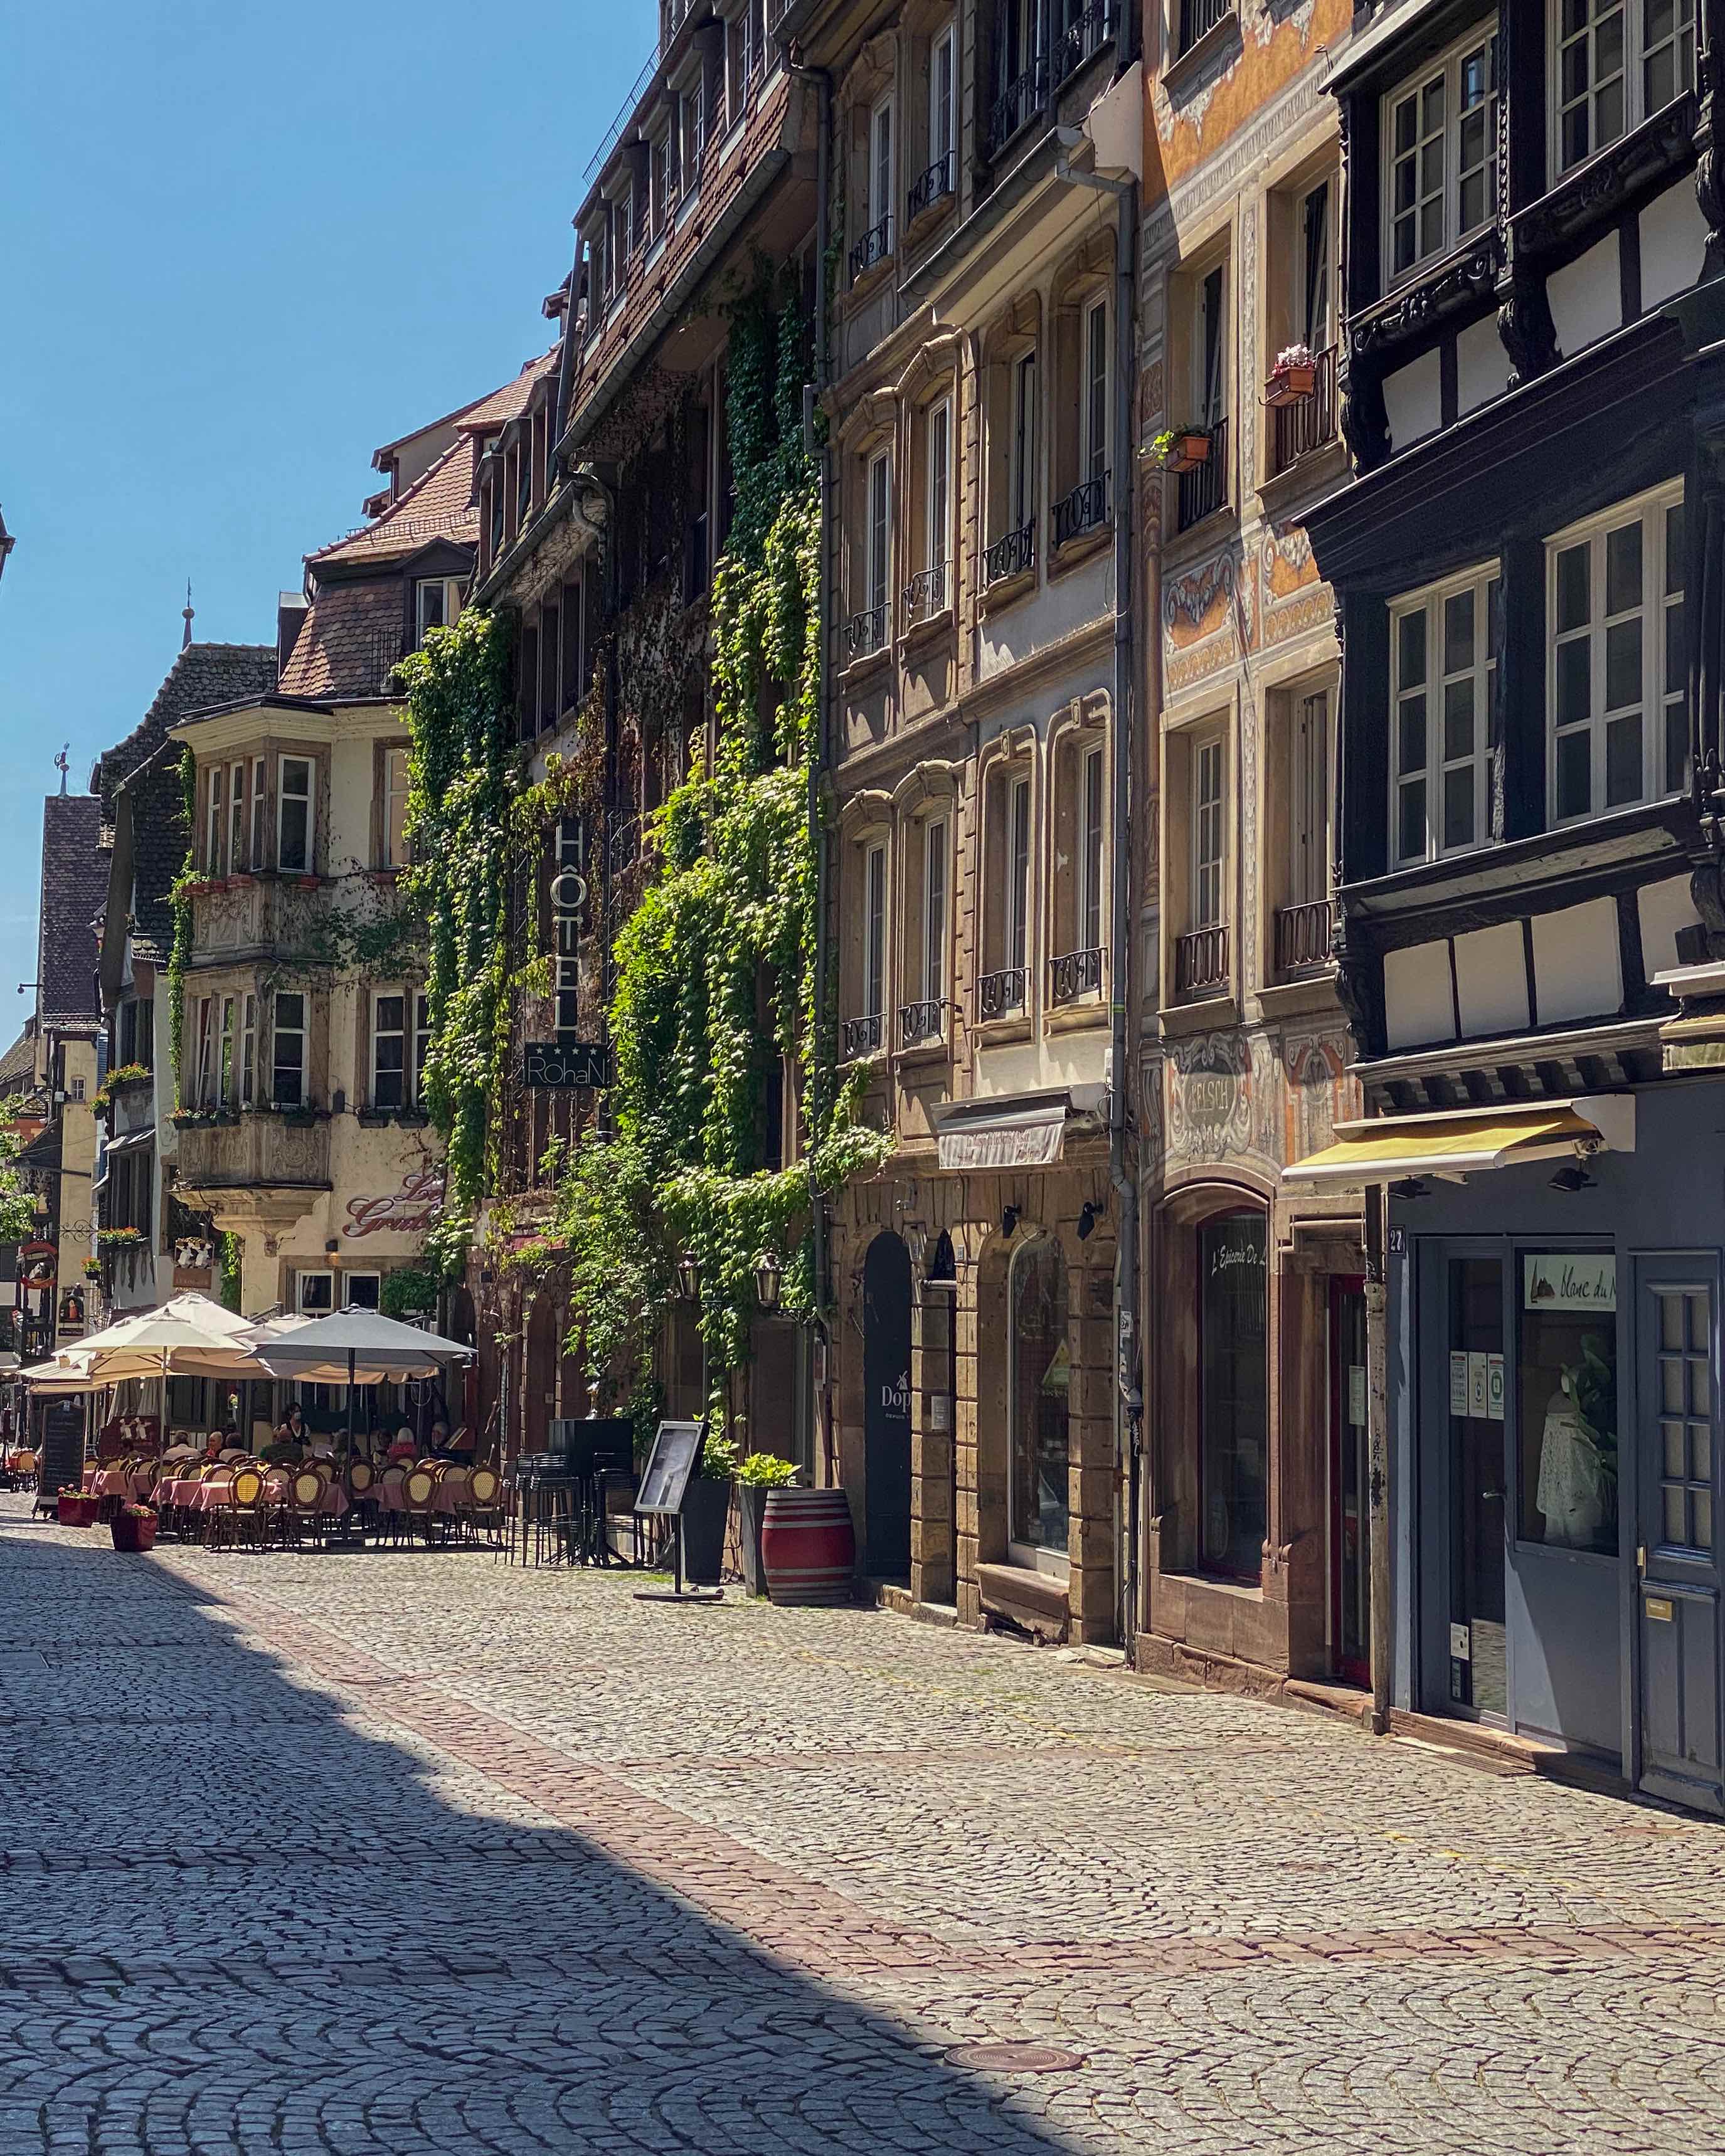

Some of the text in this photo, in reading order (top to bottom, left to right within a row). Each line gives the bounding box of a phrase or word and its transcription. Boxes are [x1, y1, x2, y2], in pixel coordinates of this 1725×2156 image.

[550, 825, 587, 1031] HÔTEL
[393, 1173, 442, 1202] Le
[1390, 1229, 1402, 1251] 27
[1560, 1264, 1591, 1298] blanc
[1593, 1269, 1607, 1299] du
